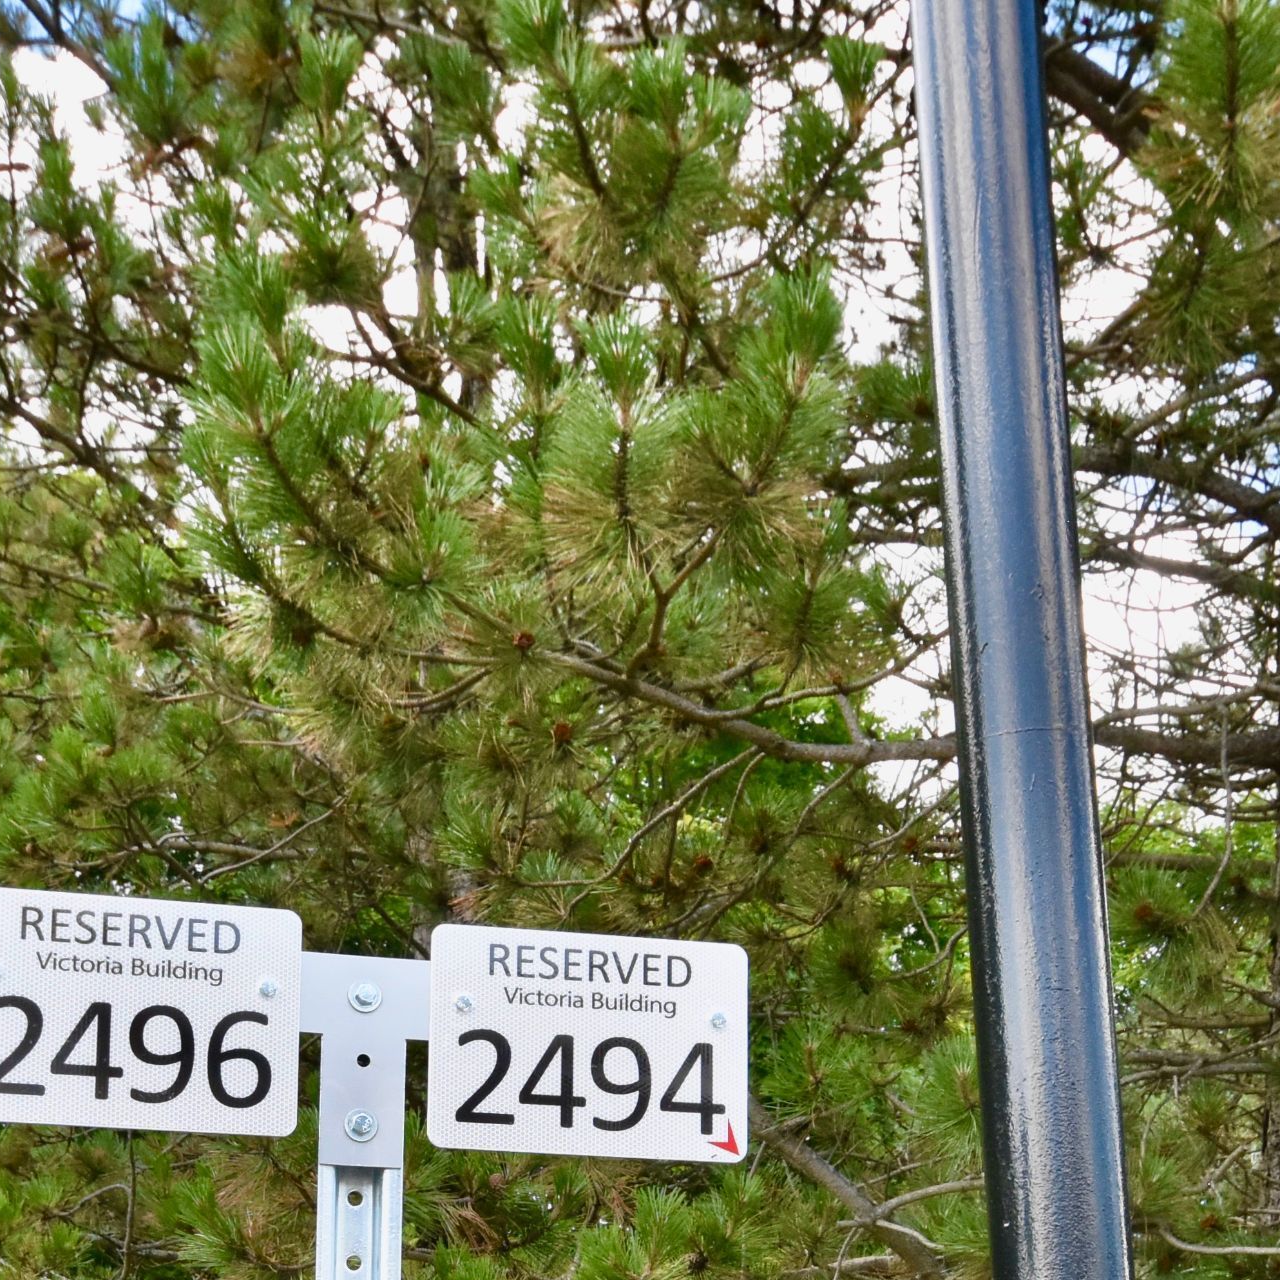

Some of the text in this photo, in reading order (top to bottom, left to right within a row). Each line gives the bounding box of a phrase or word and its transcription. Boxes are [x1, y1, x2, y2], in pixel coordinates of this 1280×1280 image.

[20, 905, 242, 955] RESERVED
[35, 951, 224, 987] Victoria Building
[488, 943, 693, 989] RESERVED
[503, 986, 677, 1019] Victoria Building
[455, 1028, 726, 1136] 2494
